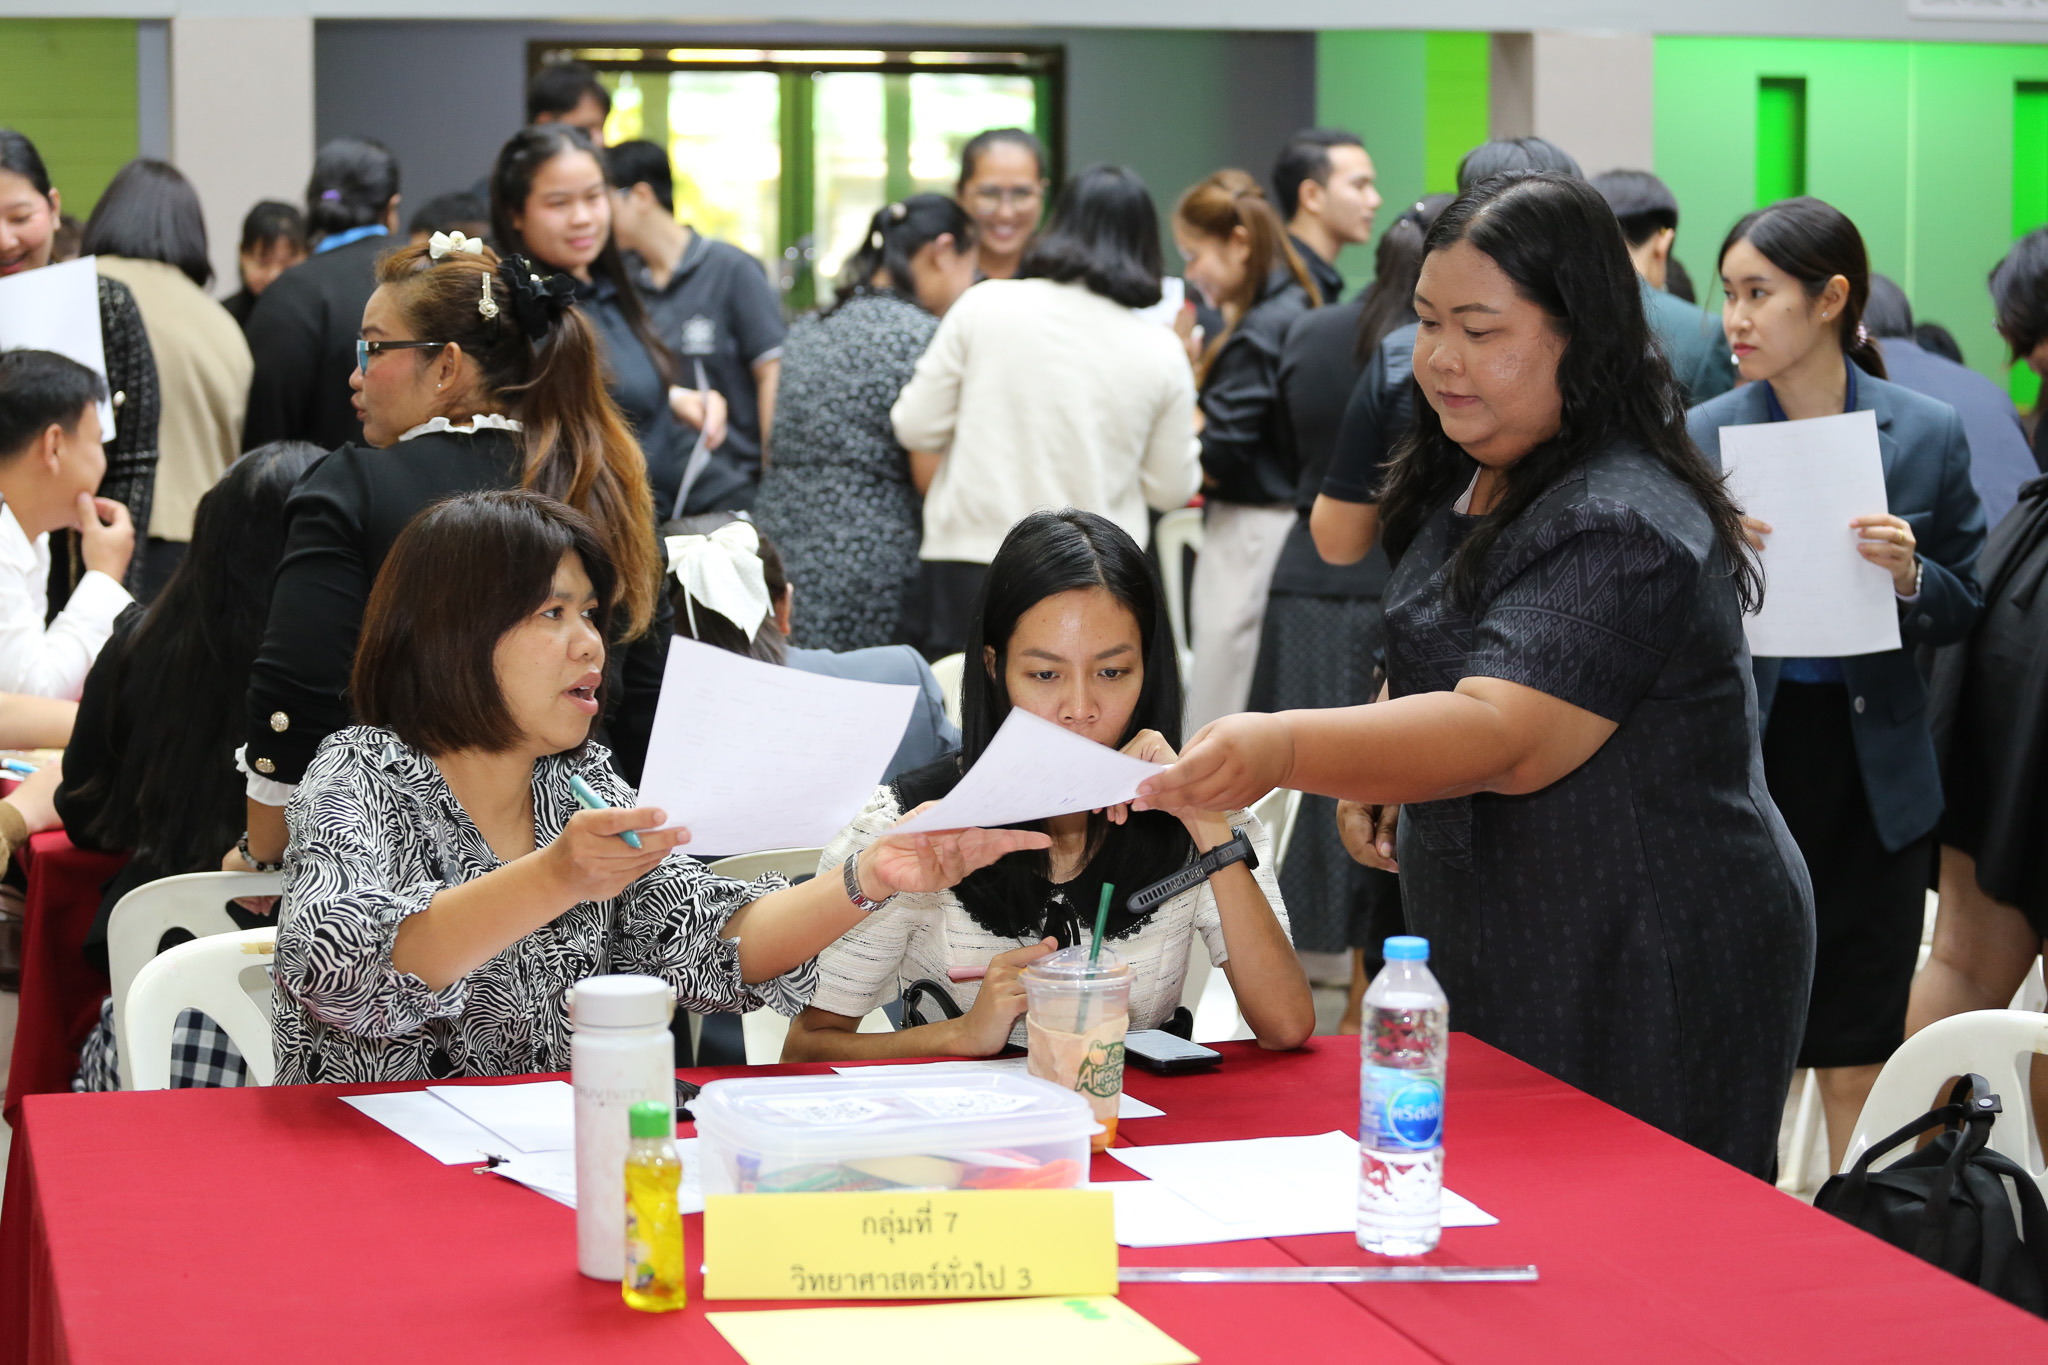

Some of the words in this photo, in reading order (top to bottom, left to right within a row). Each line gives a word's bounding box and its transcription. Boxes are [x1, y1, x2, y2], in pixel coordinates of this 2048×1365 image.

[862, 1199, 933, 1244] กลุ่มที่
[943, 1212, 959, 1233] 7
[791, 1256, 1005, 1292] วิทยาศาสตร์ทั่วไป
[1017, 1268, 1033, 1290] 3
